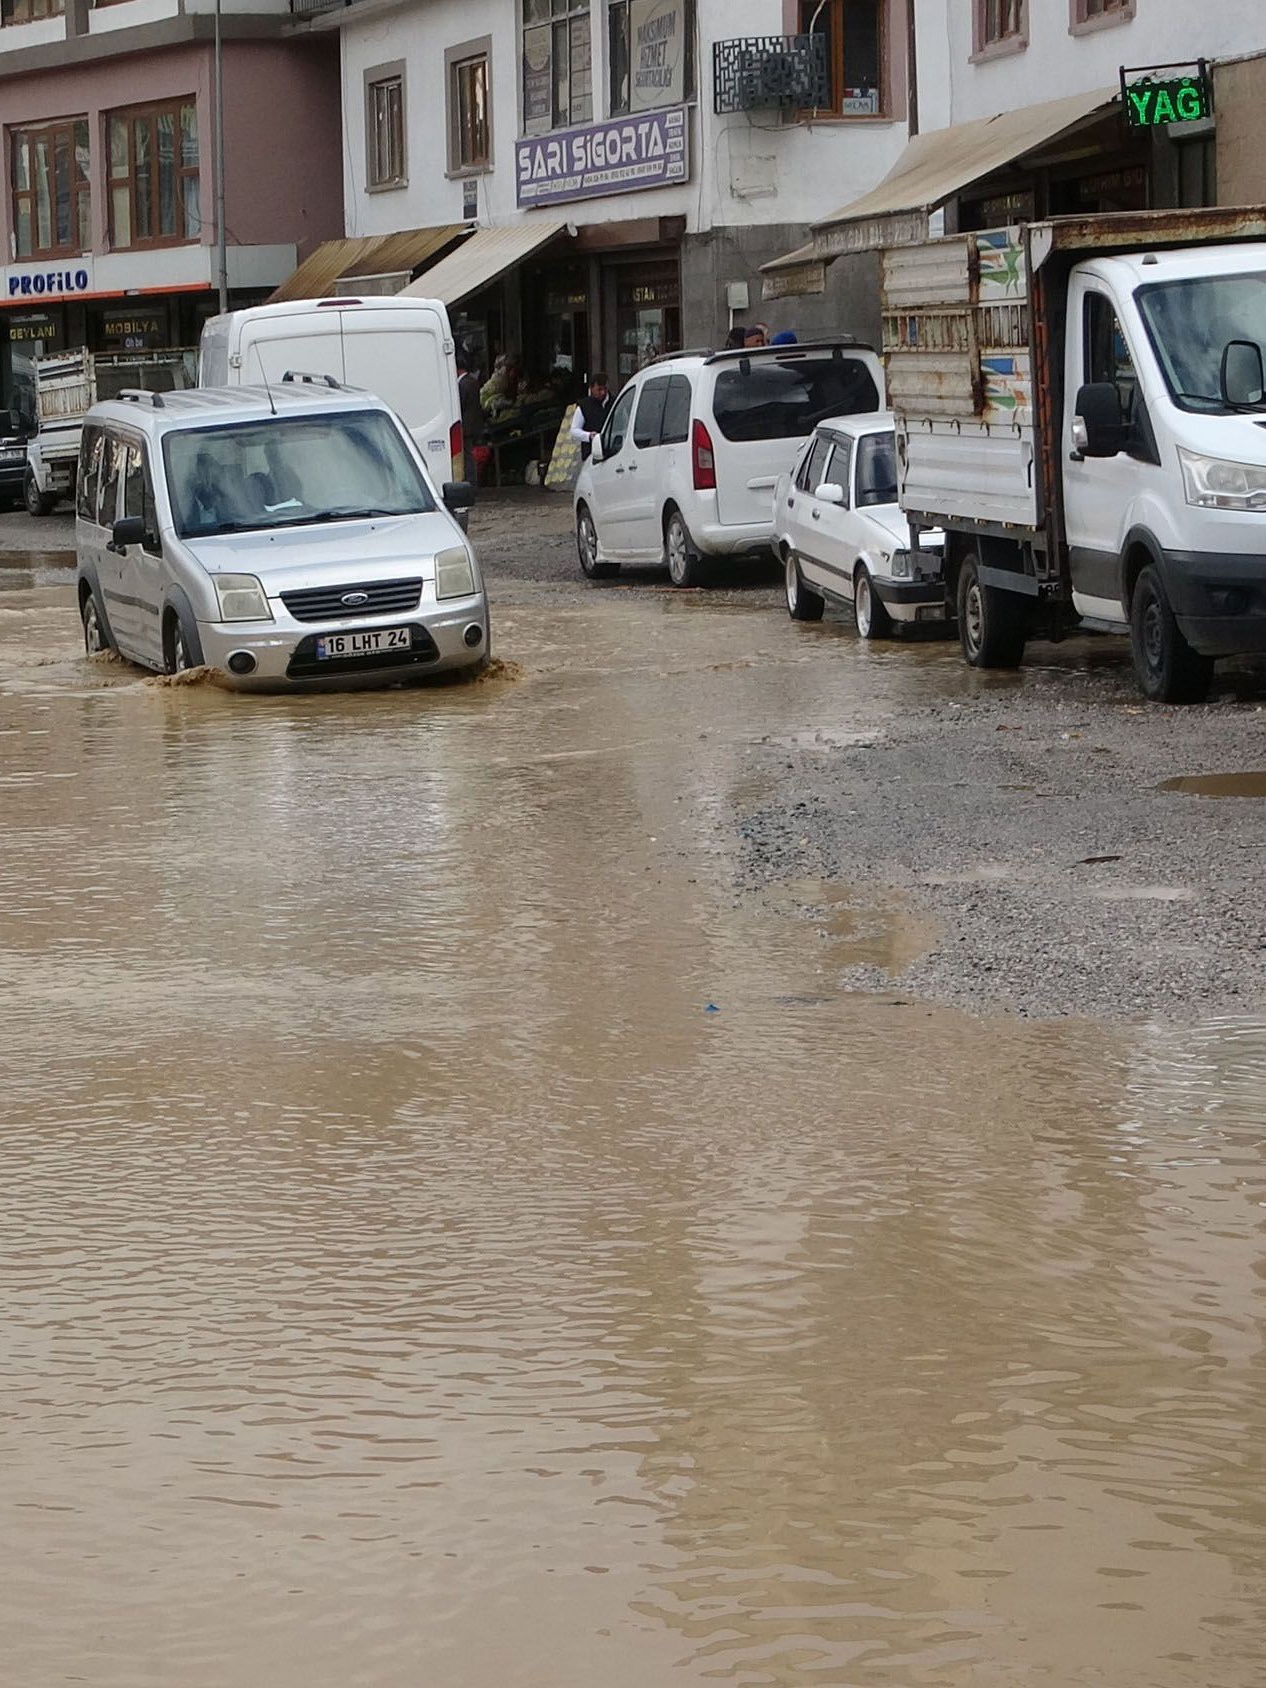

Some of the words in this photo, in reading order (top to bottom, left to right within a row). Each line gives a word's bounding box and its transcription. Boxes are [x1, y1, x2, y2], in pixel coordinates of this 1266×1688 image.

[1130, 79, 1201, 124] YAĞ
[519, 139, 567, 181] SARI
[328, 637, 345, 653] 16
[352, 633, 381, 651] LHT
[388, 630, 407, 647] 24
